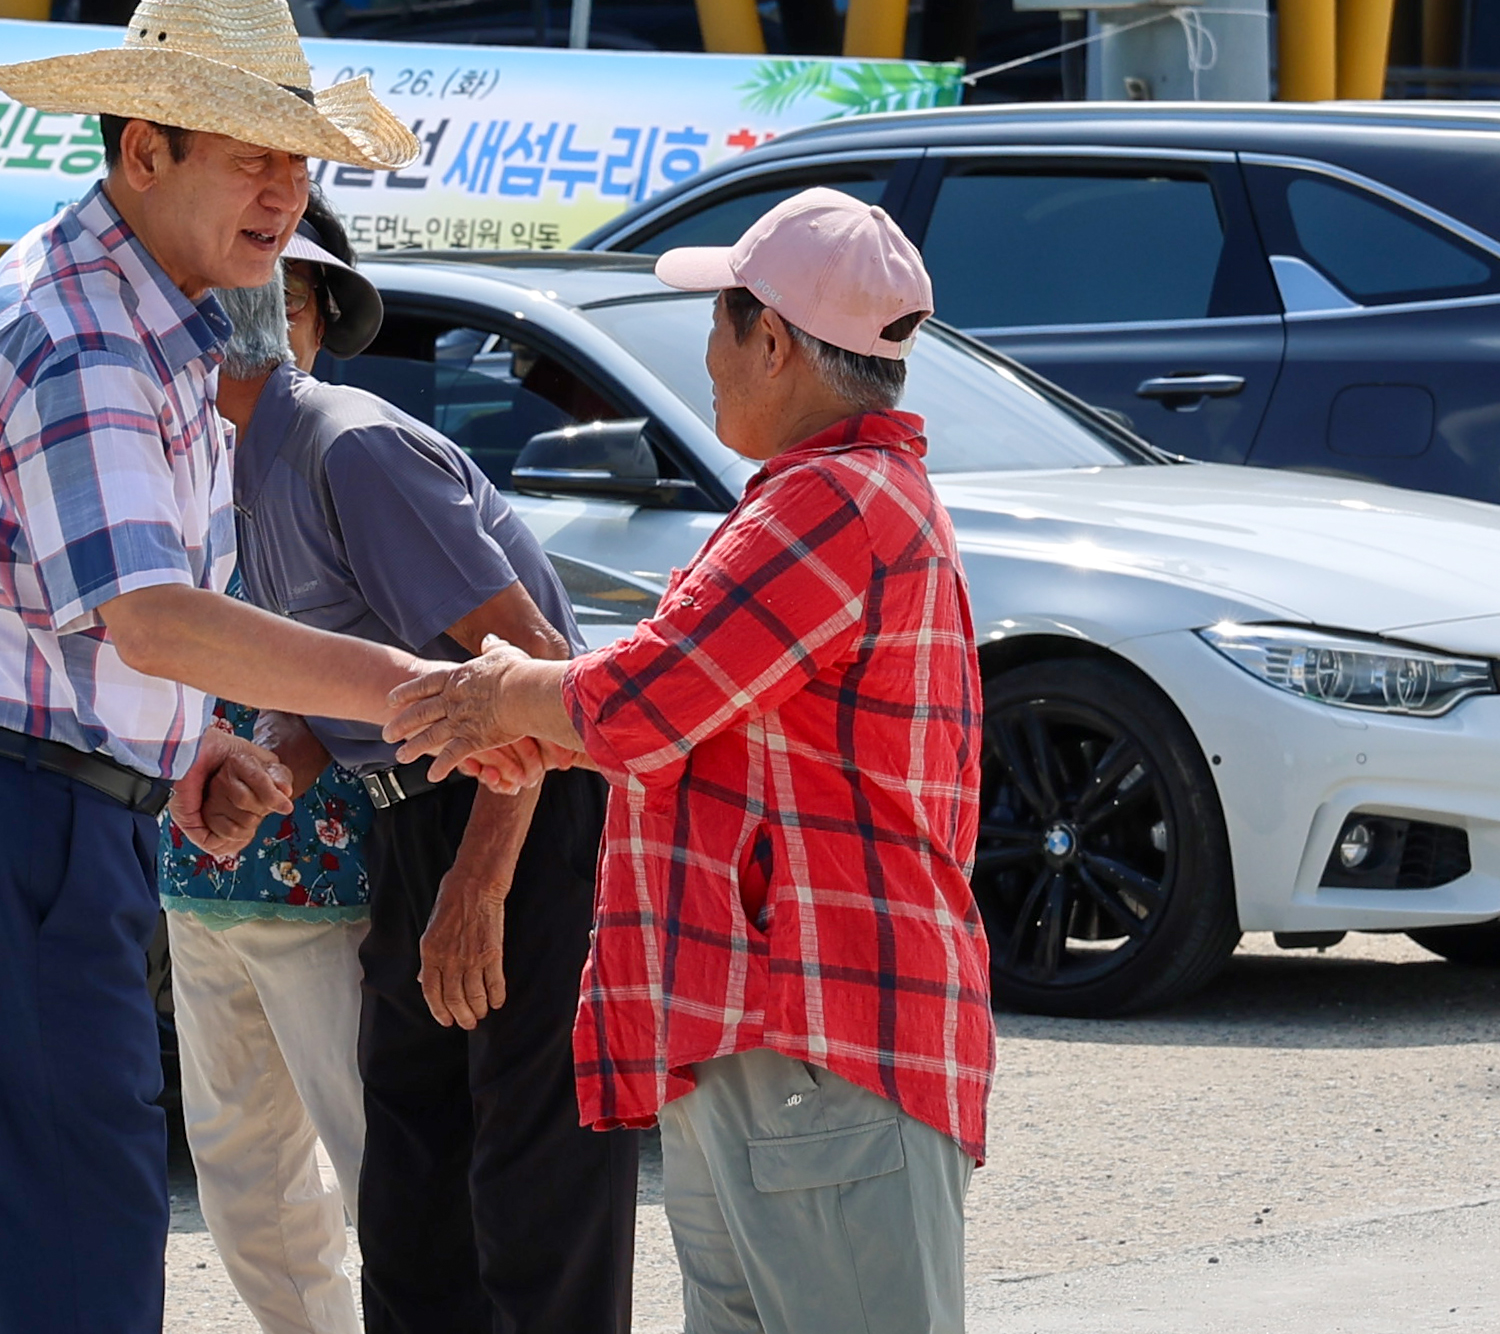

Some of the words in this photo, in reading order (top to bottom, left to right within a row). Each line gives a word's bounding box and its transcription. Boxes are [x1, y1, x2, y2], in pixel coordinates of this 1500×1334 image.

[442, 120, 709, 202] 새섬누리호
[343, 214, 500, 249] 도면노인회원
[753, 278, 783, 304] MORE
